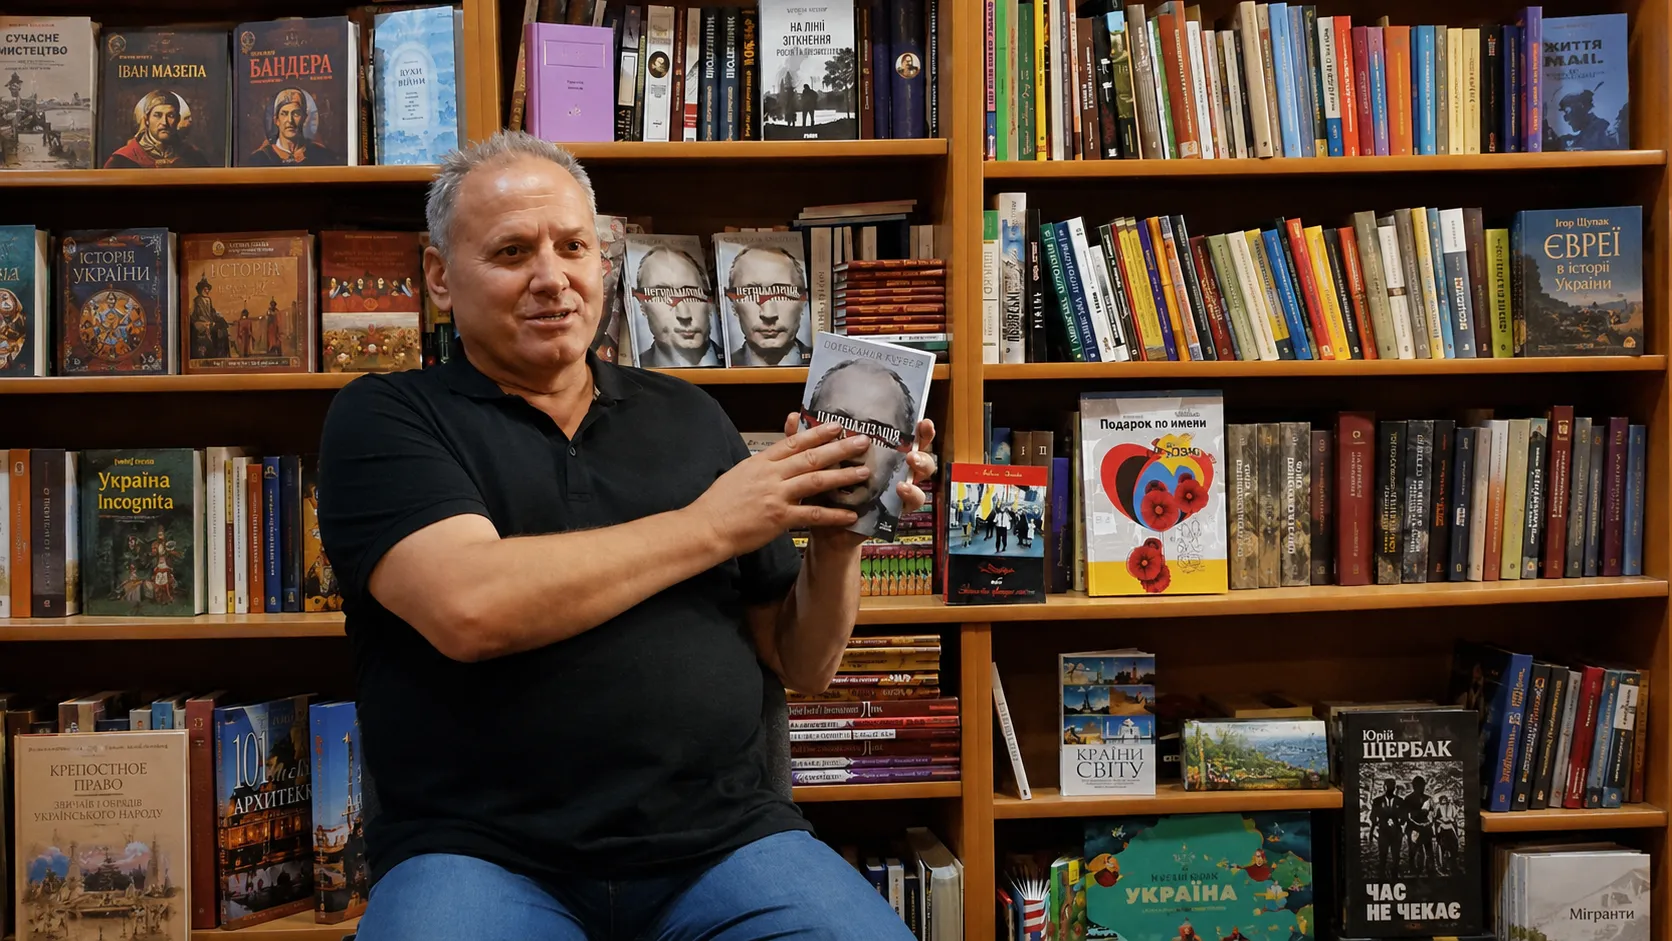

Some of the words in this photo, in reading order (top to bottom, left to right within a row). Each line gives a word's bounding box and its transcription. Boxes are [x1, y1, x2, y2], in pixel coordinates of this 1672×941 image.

[790, 22, 802, 32] НА
[804, 19, 825, 32] ЛІНІЇ
[5, 33, 60, 43] СУЧАСНЕ
[782, 34, 831, 46] ЗІТКНЕННЯ
[1544, 39, 1602, 52] ЖИТТЯ
[0, 45, 68, 56] МИСТЕЦТВО
[118, 64, 149, 78] ІВАН
[151, 64, 207, 78] МАЗЕПА
[250, 54, 333, 79] БАНДЕРА
[1555, 218, 1575, 230] Ігор
[1577, 217, 1610, 229] Щупак
[1543, 226, 1621, 259] ЄВРЕЇ
[80, 250, 135, 264] ІСТОРІЯ
[73, 263, 150, 284] УКРАЇНИ
[1556, 263, 1565, 275] в
[1568, 260, 1610, 277] історії
[1100, 418, 1152, 431] Подарок
[1155, 420, 1168, 429] по
[1171, 419, 1207, 429] имени
[98, 471, 171, 493] Україна
[98, 493, 174, 514] Incognita
[1362, 729, 1394, 744] Юрій
[1077, 746, 1144, 761] КРАЇНИ
[1362, 740, 1453, 761] ЩЕРБАК
[232, 731, 269, 790] 101
[50, 762, 148, 777] КРЕПОСТНОЕ
[1076, 761, 1144, 779] СВІТУ
[74, 778, 123, 792] ПРАВО
[119, 808, 164, 819] НАРОДУ
[1125, 880, 1238, 905] УКРАЇНА
[1366, 883, 1407, 901] ЧАС
[1366, 903, 1392, 921] НЕ
[1397, 902, 1461, 920] ЧЕКАЄ
[1569, 907, 1635, 923] Мігранти
